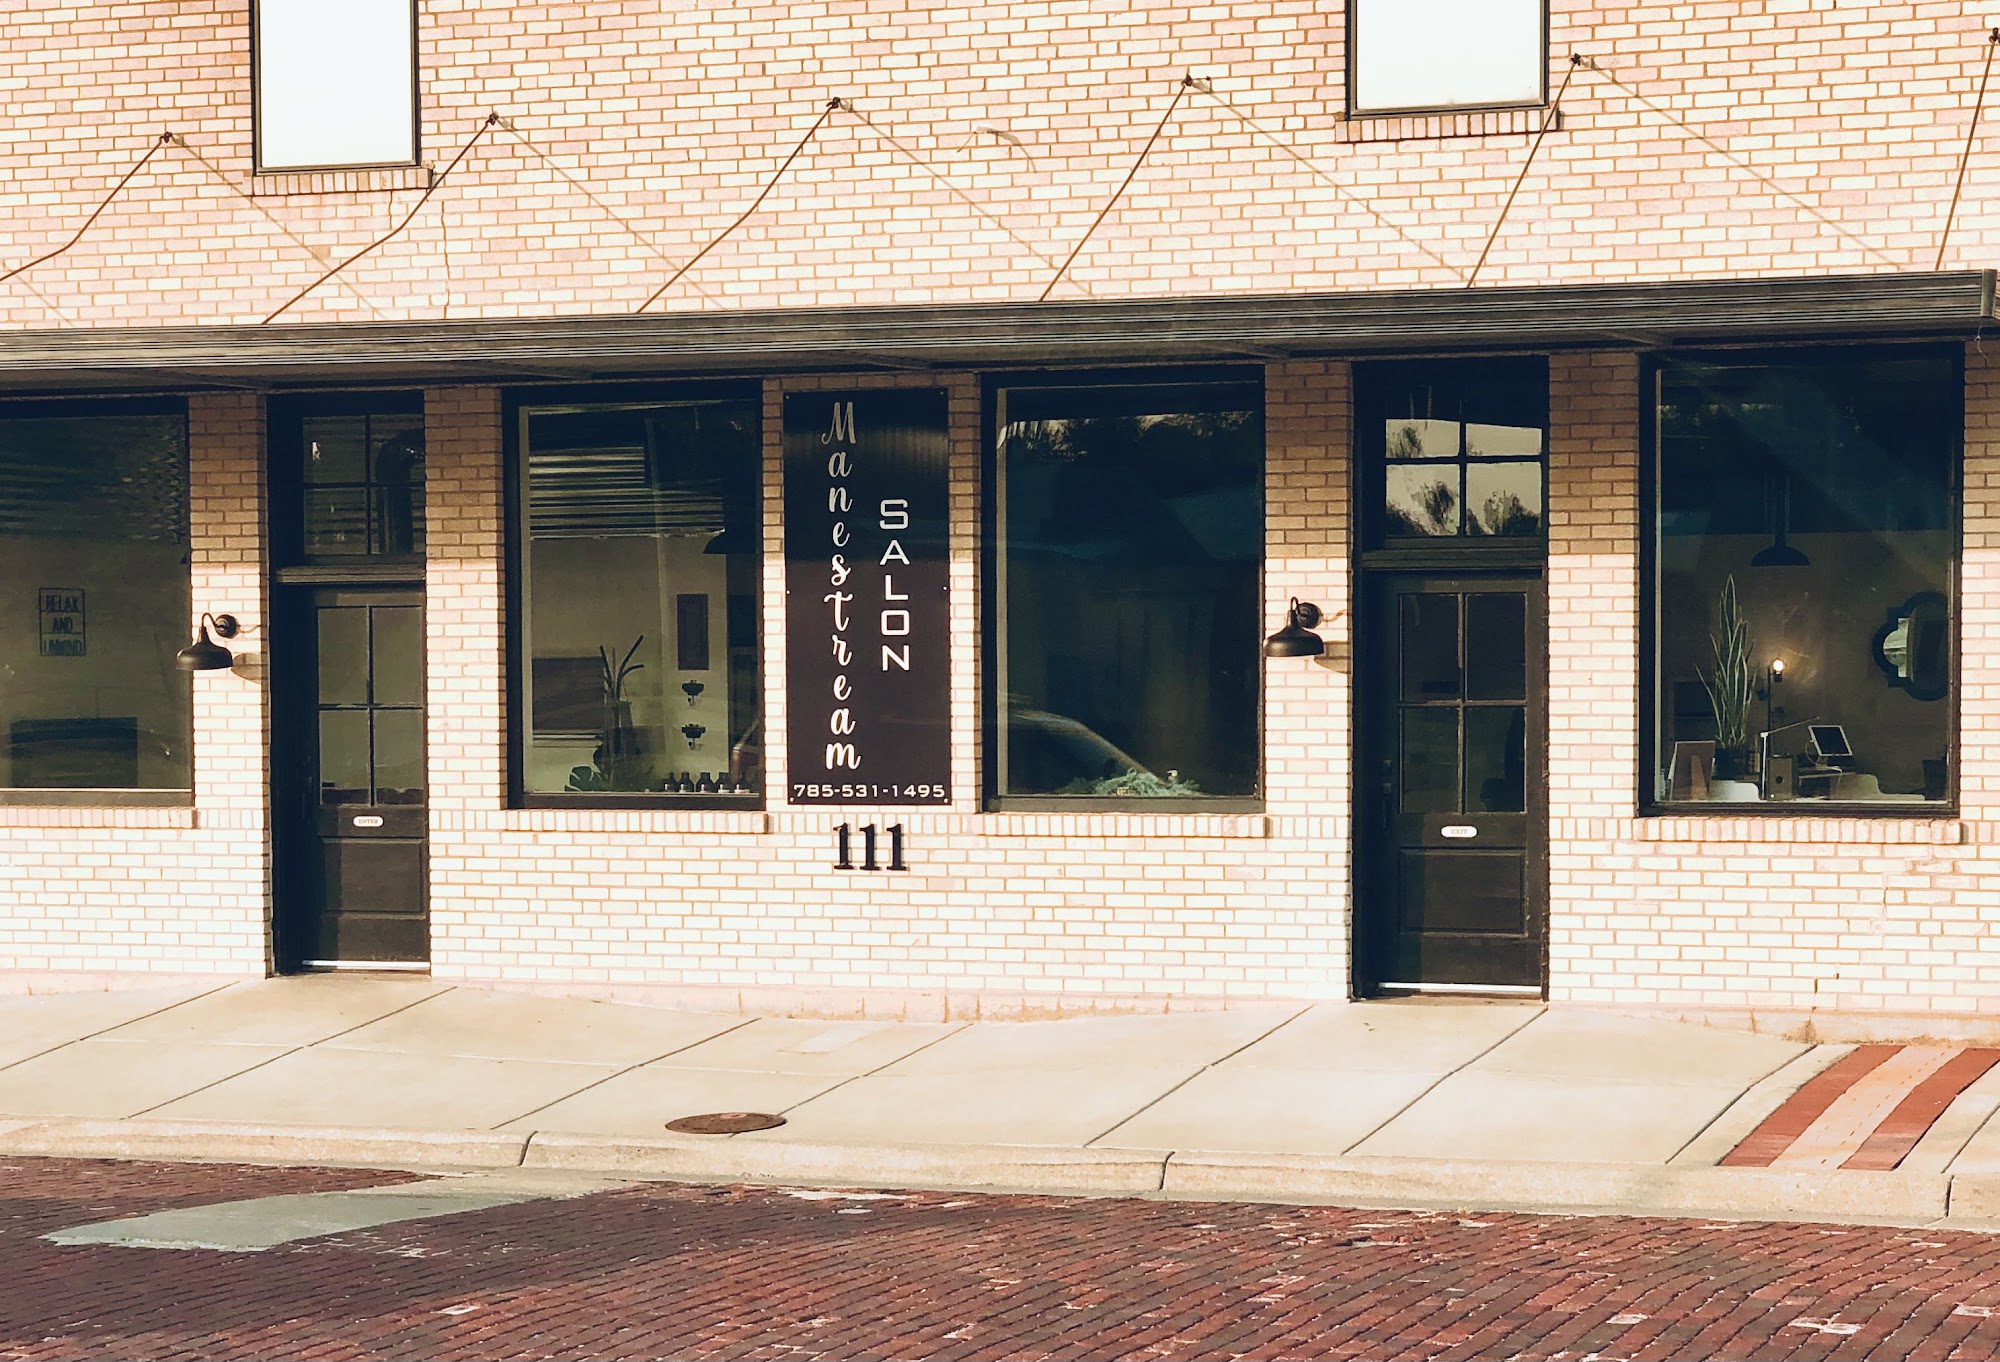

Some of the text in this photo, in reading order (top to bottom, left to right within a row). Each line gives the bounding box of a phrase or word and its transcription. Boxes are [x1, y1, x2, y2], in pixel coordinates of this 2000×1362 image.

[821, 401, 861, 771] Manestream
[879, 498, 910, 672] SALON
[52, 617, 73, 633] AND
[793, 784, 946, 799] 785-531-1495
[832, 822, 908, 871] 111
